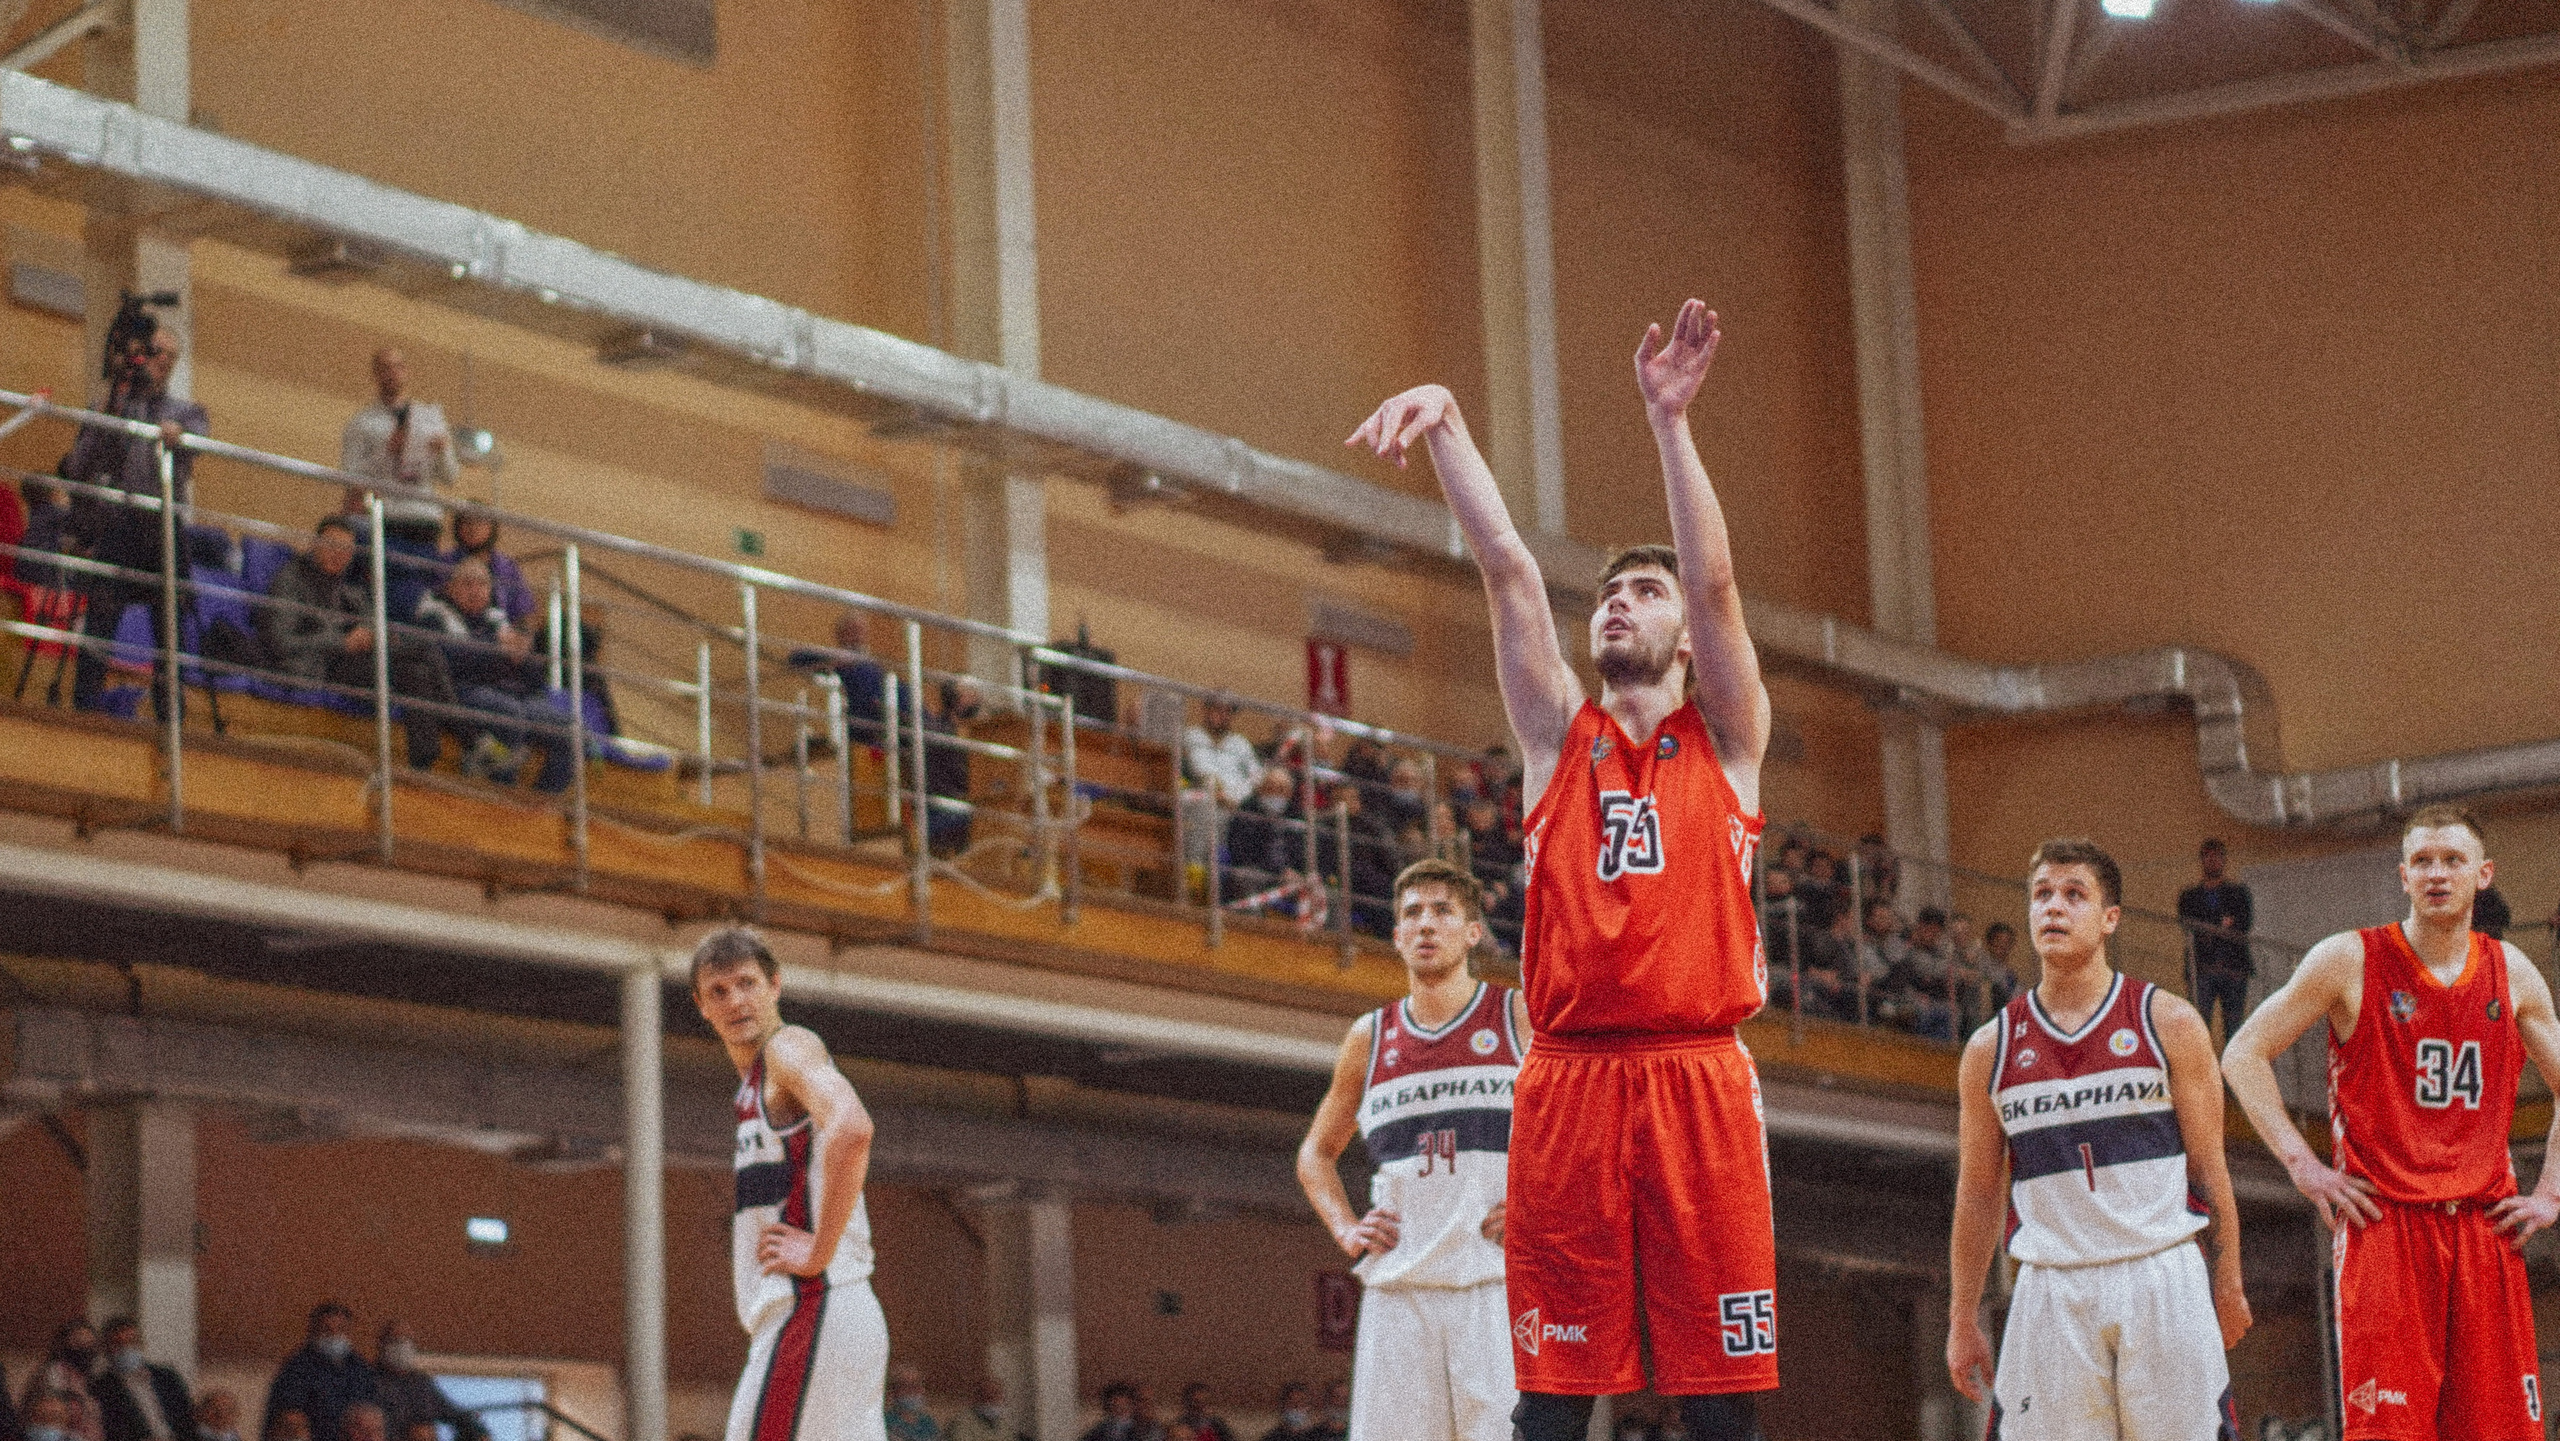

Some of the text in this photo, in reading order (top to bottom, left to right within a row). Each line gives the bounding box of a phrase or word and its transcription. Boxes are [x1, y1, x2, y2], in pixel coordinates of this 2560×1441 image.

[1596, 790, 1665, 882] 55
[2001, 1081, 2165, 1123] БК БАРНАУЛ
[2415, 1038, 2483, 1110] 34
[1417, 1128, 1457, 1178] 34
[2078, 1142, 2096, 1192] 1
[1718, 1288, 1776, 1357] 55
